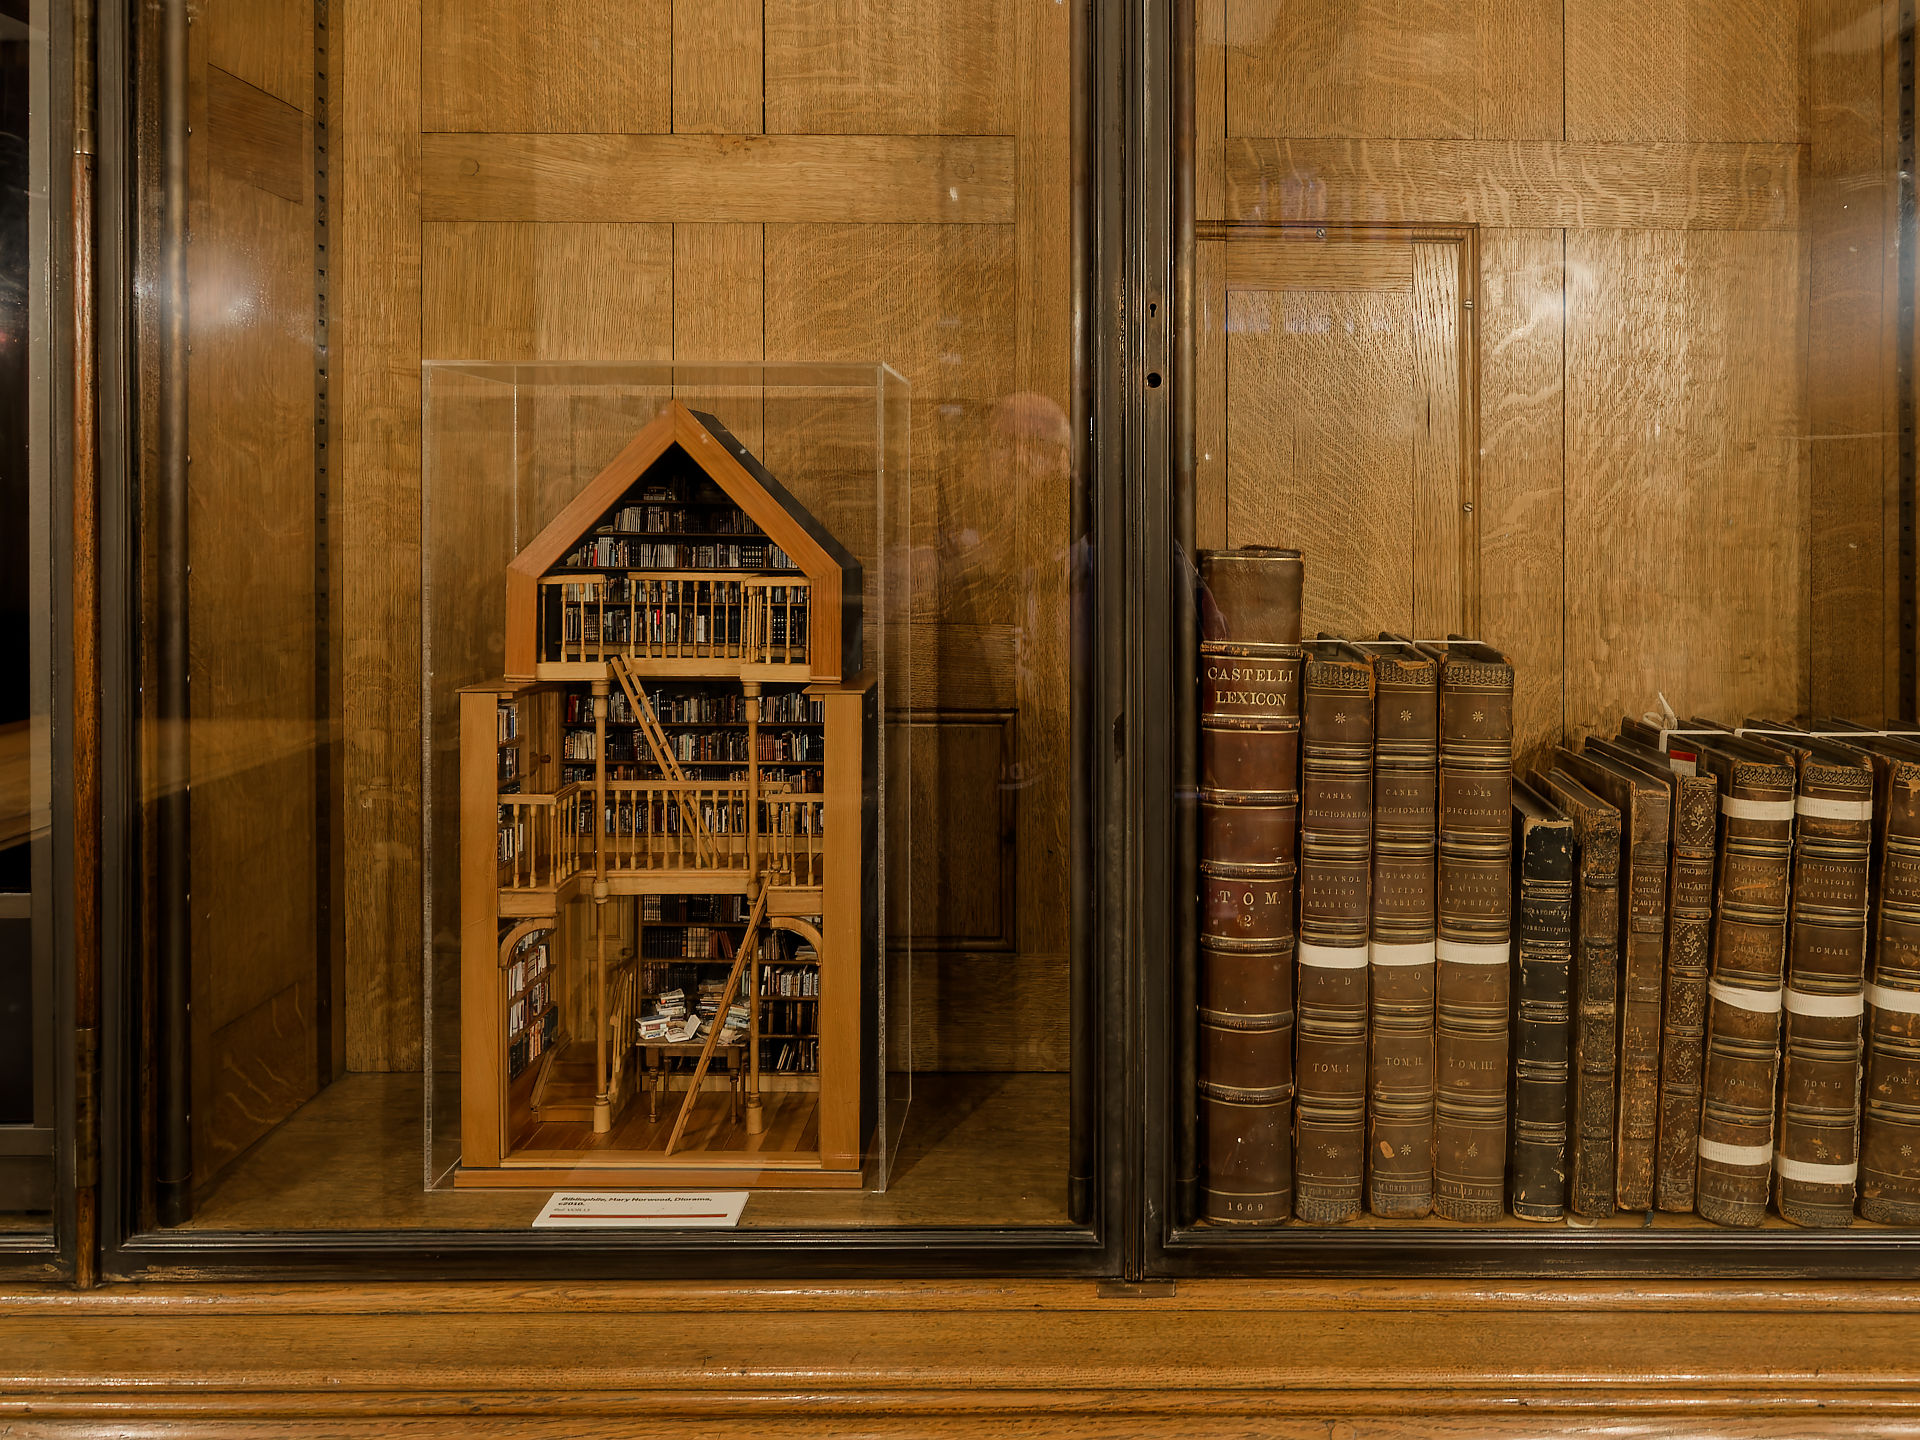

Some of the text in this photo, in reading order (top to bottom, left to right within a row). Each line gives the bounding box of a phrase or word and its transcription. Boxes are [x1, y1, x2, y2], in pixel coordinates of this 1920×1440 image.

[1207, 666, 1294, 683] CASTELLI
[1215, 690, 1287, 707] LEXICON
[1319, 791, 1353, 800] CANES
[1385, 788, 1420, 797] CANES
[1457, 788, 1492, 798] CANES
[1308, 809, 1368, 819] DICCIONARIO
[1377, 806, 1433, 815] DICCIONARIO
[1446, 807, 1508, 817] DICCIONARIO
[1313, 887, 1355, 896] LATINO
[1382, 886, 1424, 895] LATINO
[1307, 900, 1358, 909] ARABICO
[1243, 914, 1253, 928] 2
[1317, 975, 1325, 985] A
[1343, 976, 1352, 986] D
[1228, 1200, 1264, 1212] 1669
